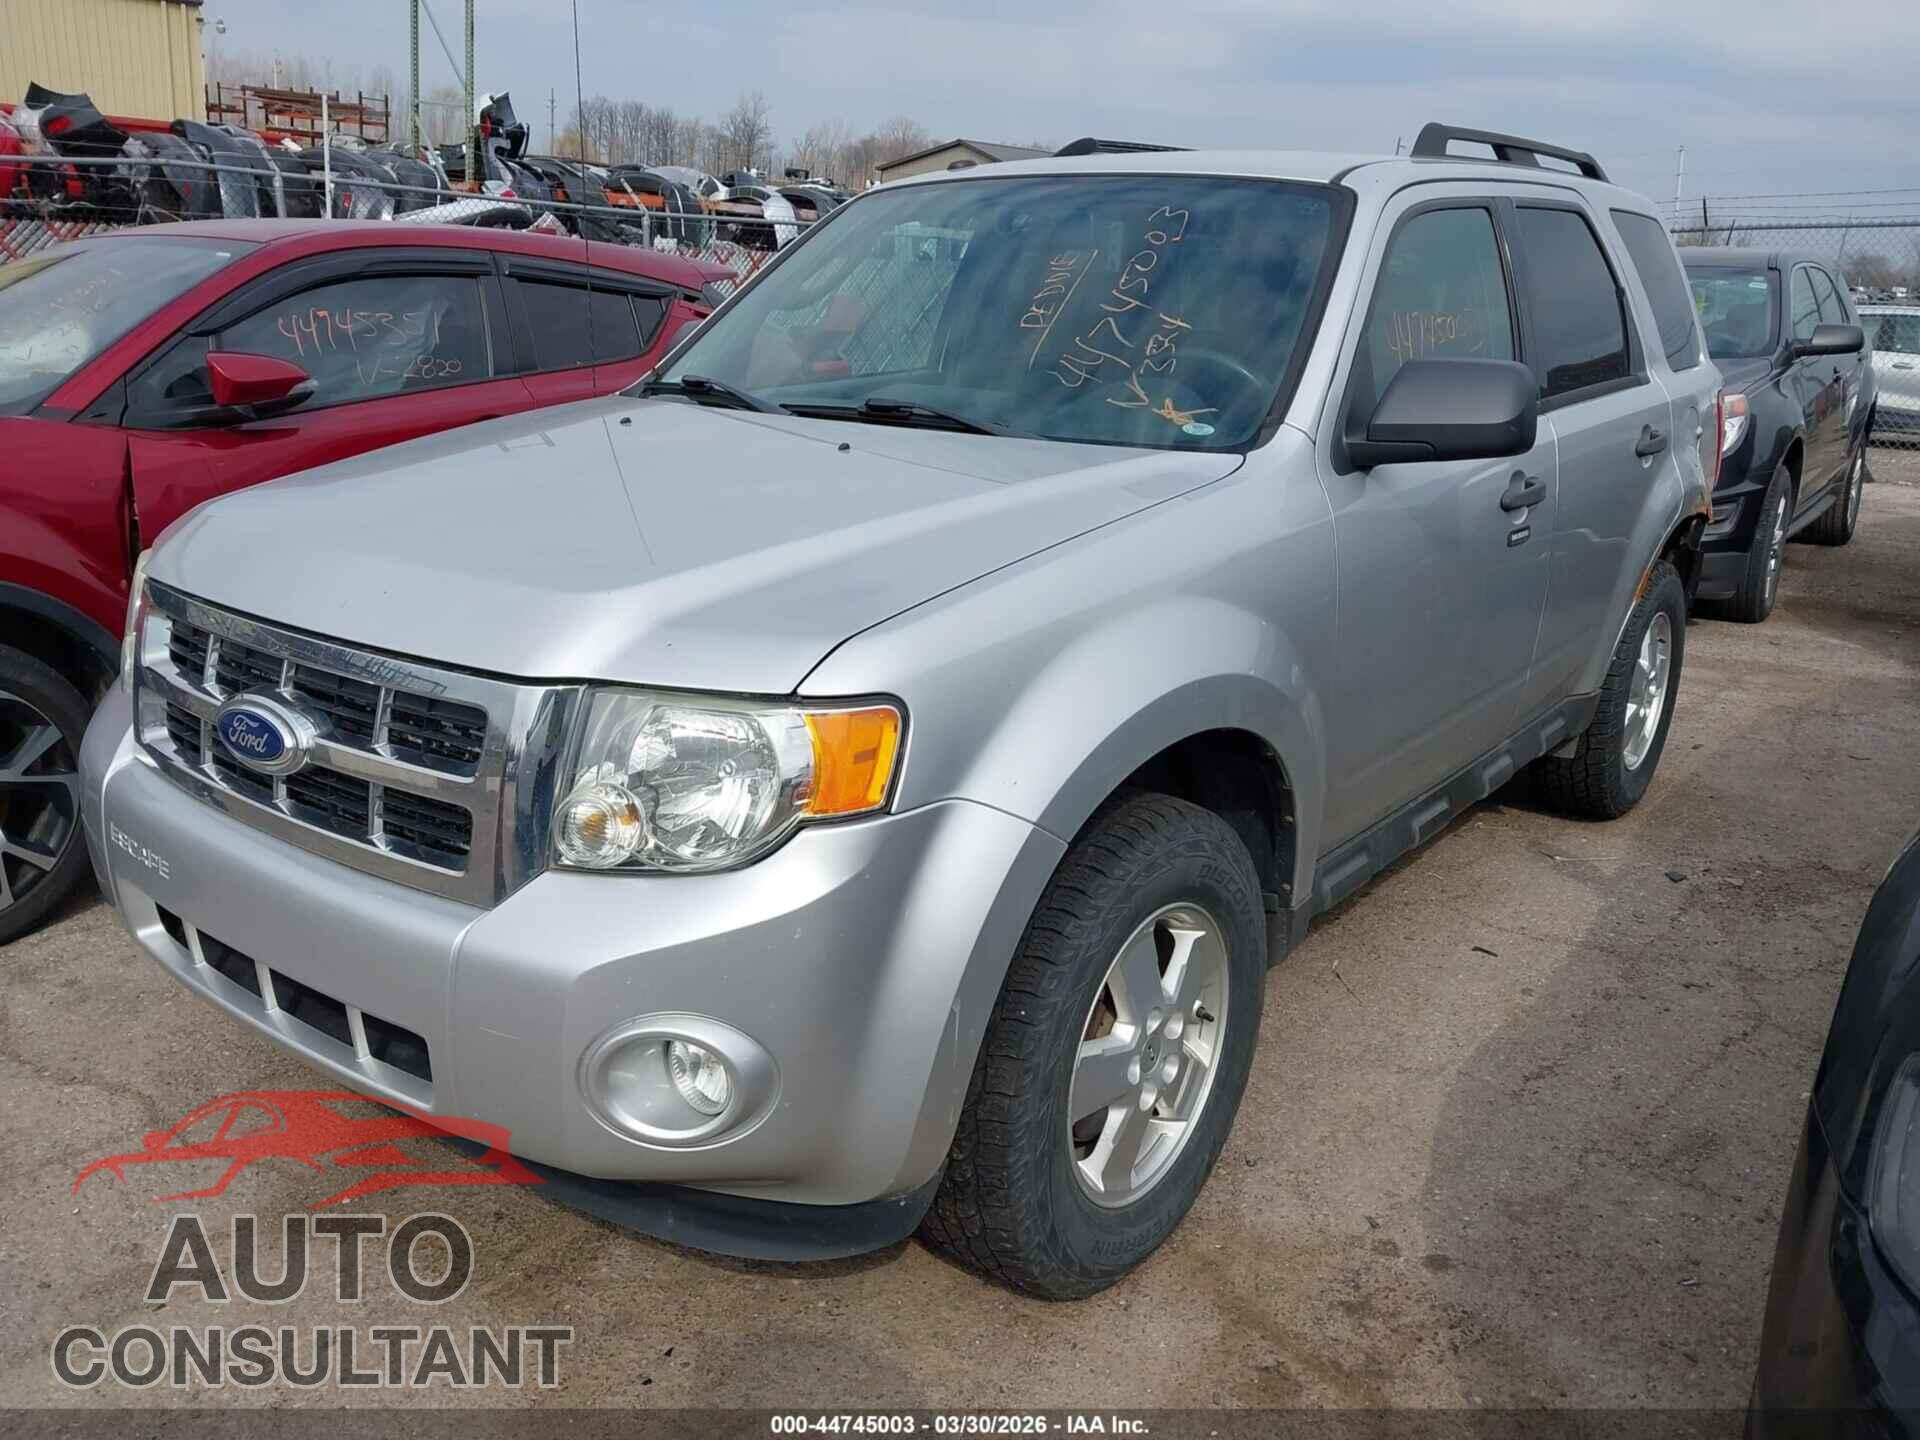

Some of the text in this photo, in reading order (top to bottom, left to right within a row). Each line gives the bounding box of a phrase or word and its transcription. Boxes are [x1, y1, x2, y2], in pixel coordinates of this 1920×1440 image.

[1047, 206, 1189, 387] 44745003
[228, 714, 270, 753] Ford
[110, 821, 170, 881] ESCAPE
